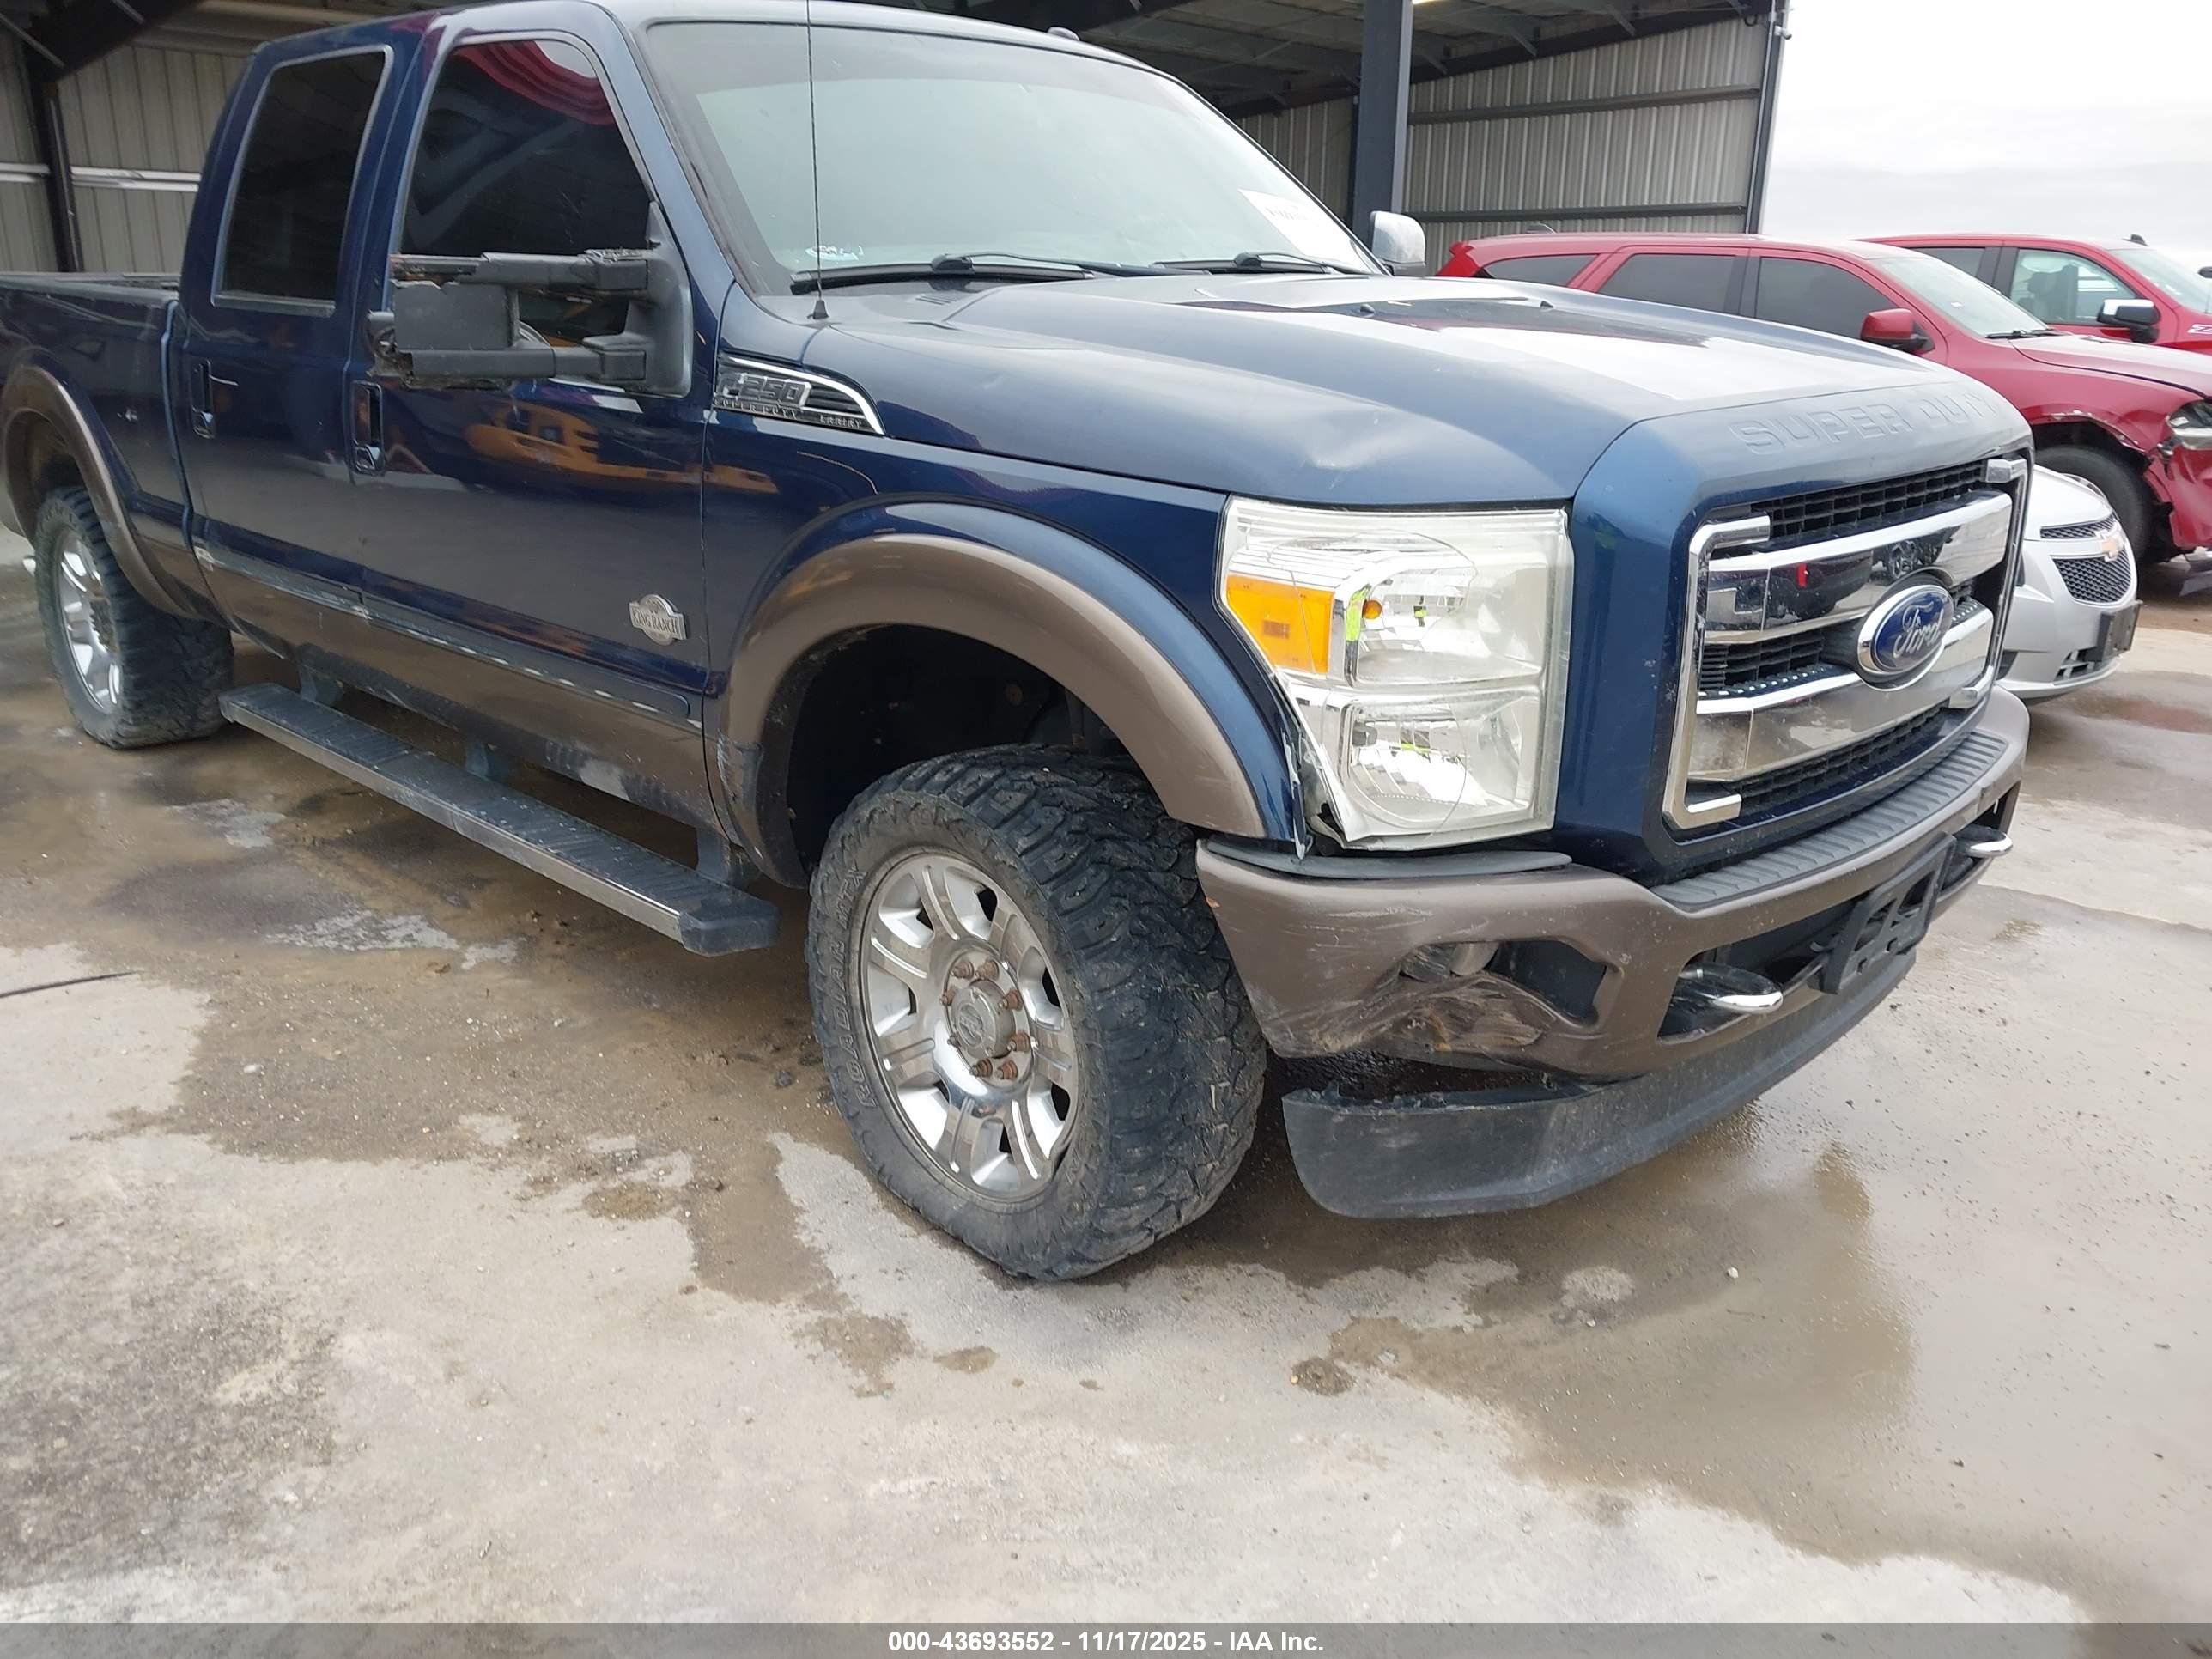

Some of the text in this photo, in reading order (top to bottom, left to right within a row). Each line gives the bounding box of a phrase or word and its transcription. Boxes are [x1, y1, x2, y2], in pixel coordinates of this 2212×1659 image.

[715, 372, 812, 408] F-250
[1729, 404, 1913, 455] SUPER
[631, 607, 680, 635] KING RANCH
[1893, 600, 1944, 659] Ford
